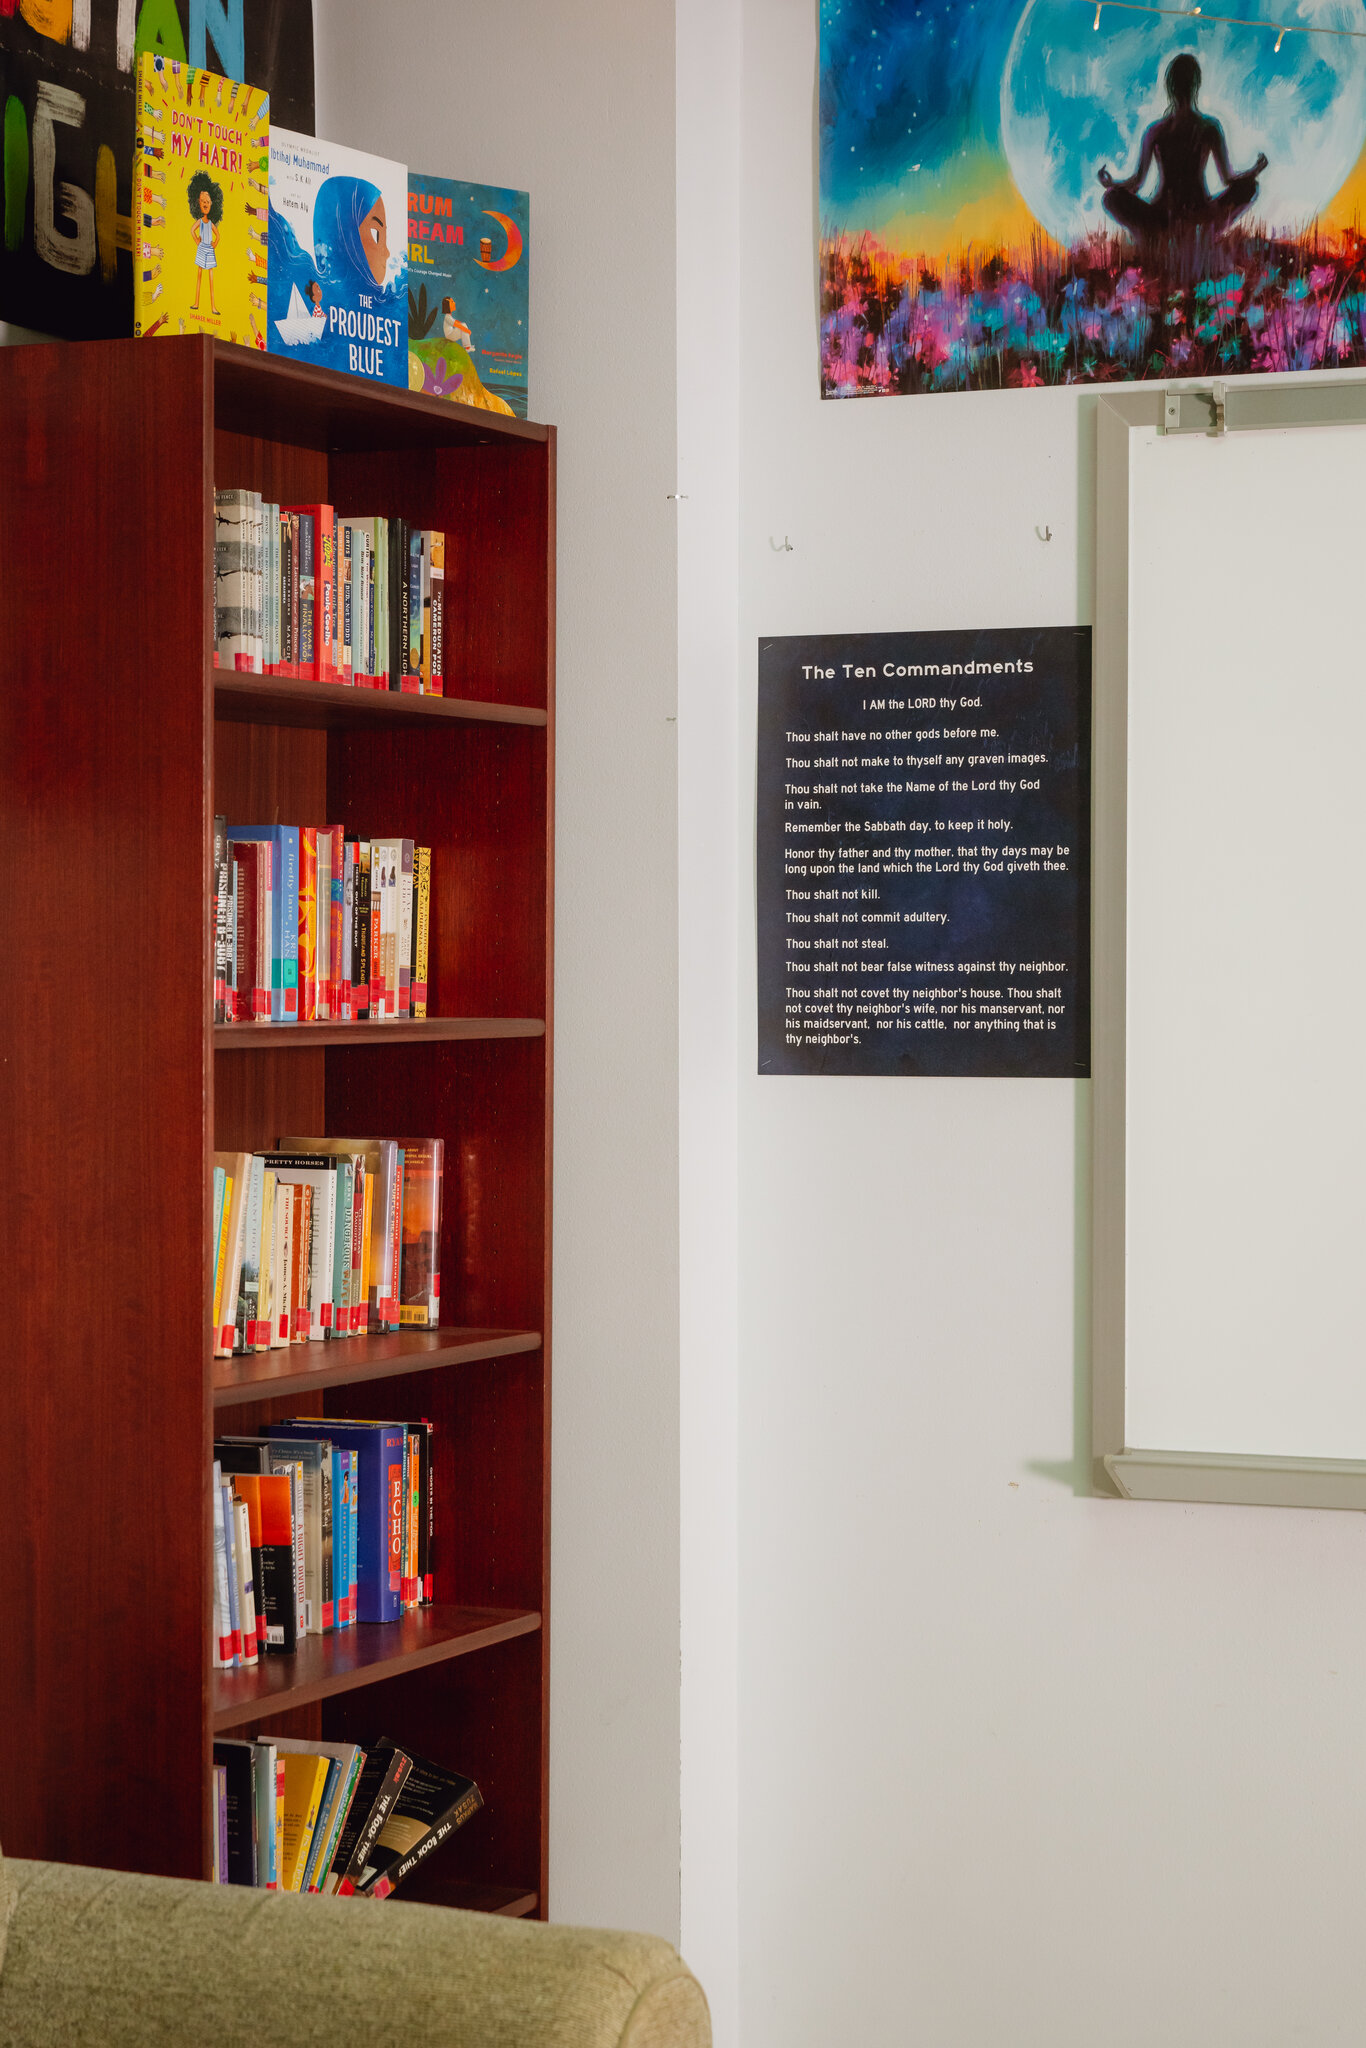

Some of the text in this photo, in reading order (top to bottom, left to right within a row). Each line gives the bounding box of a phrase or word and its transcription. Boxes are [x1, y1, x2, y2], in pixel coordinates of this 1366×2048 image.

[172, 109, 242, 146] DON'T TOUCH
[171, 131, 242, 175] MY HAIR!
[270, 147, 291, 166] Ibtihaj
[293, 154, 330, 175] Muhammad
[408, 192, 453, 218] RUM
[408, 218, 464, 246] REAM
[408, 243, 435, 265] IRL
[358, 293, 373, 310] THE
[329, 305, 402, 348] PROUDEST
[349, 343, 384, 377] BLUE
[802, 659, 1034, 680] The Ten Commandments
[863, 696, 983, 711] I AM the LORD thy God.
[785, 727, 999, 742] Thou shalt have no other gods before me.
[785, 753, 1048, 768] Thou shalt not make to thyself any graven images.
[785, 779, 1040, 794] Thou shalt not take the Name of the Lord thy God
[785, 799, 822, 810] in vain.
[785, 819, 1013, 834] Remember the Sabbath day, to keep it holy.
[785, 845, 1070, 861] Honor thy father and thy mother, that thy days may be
[287, 853, 295, 889] firefly
[785, 860, 1069, 877] long upon the land which the Lord thy God giveth thee.
[785, 889, 880, 900] Thou shalt not kill.
[785, 911, 950, 925] Thou shalt not commit adultery.
[264, 1158, 293, 1166] PRETTY
[343, 1207, 352, 1268] DANGEROUS
[392, 1481, 401, 1554] ECHO
[357, 1794, 391, 1865] THE BOOK THIEF
[436, 1822, 452, 1840] THE
[417, 1836, 438, 1859] BOOK
[398, 1856, 418, 1878] THIEF
